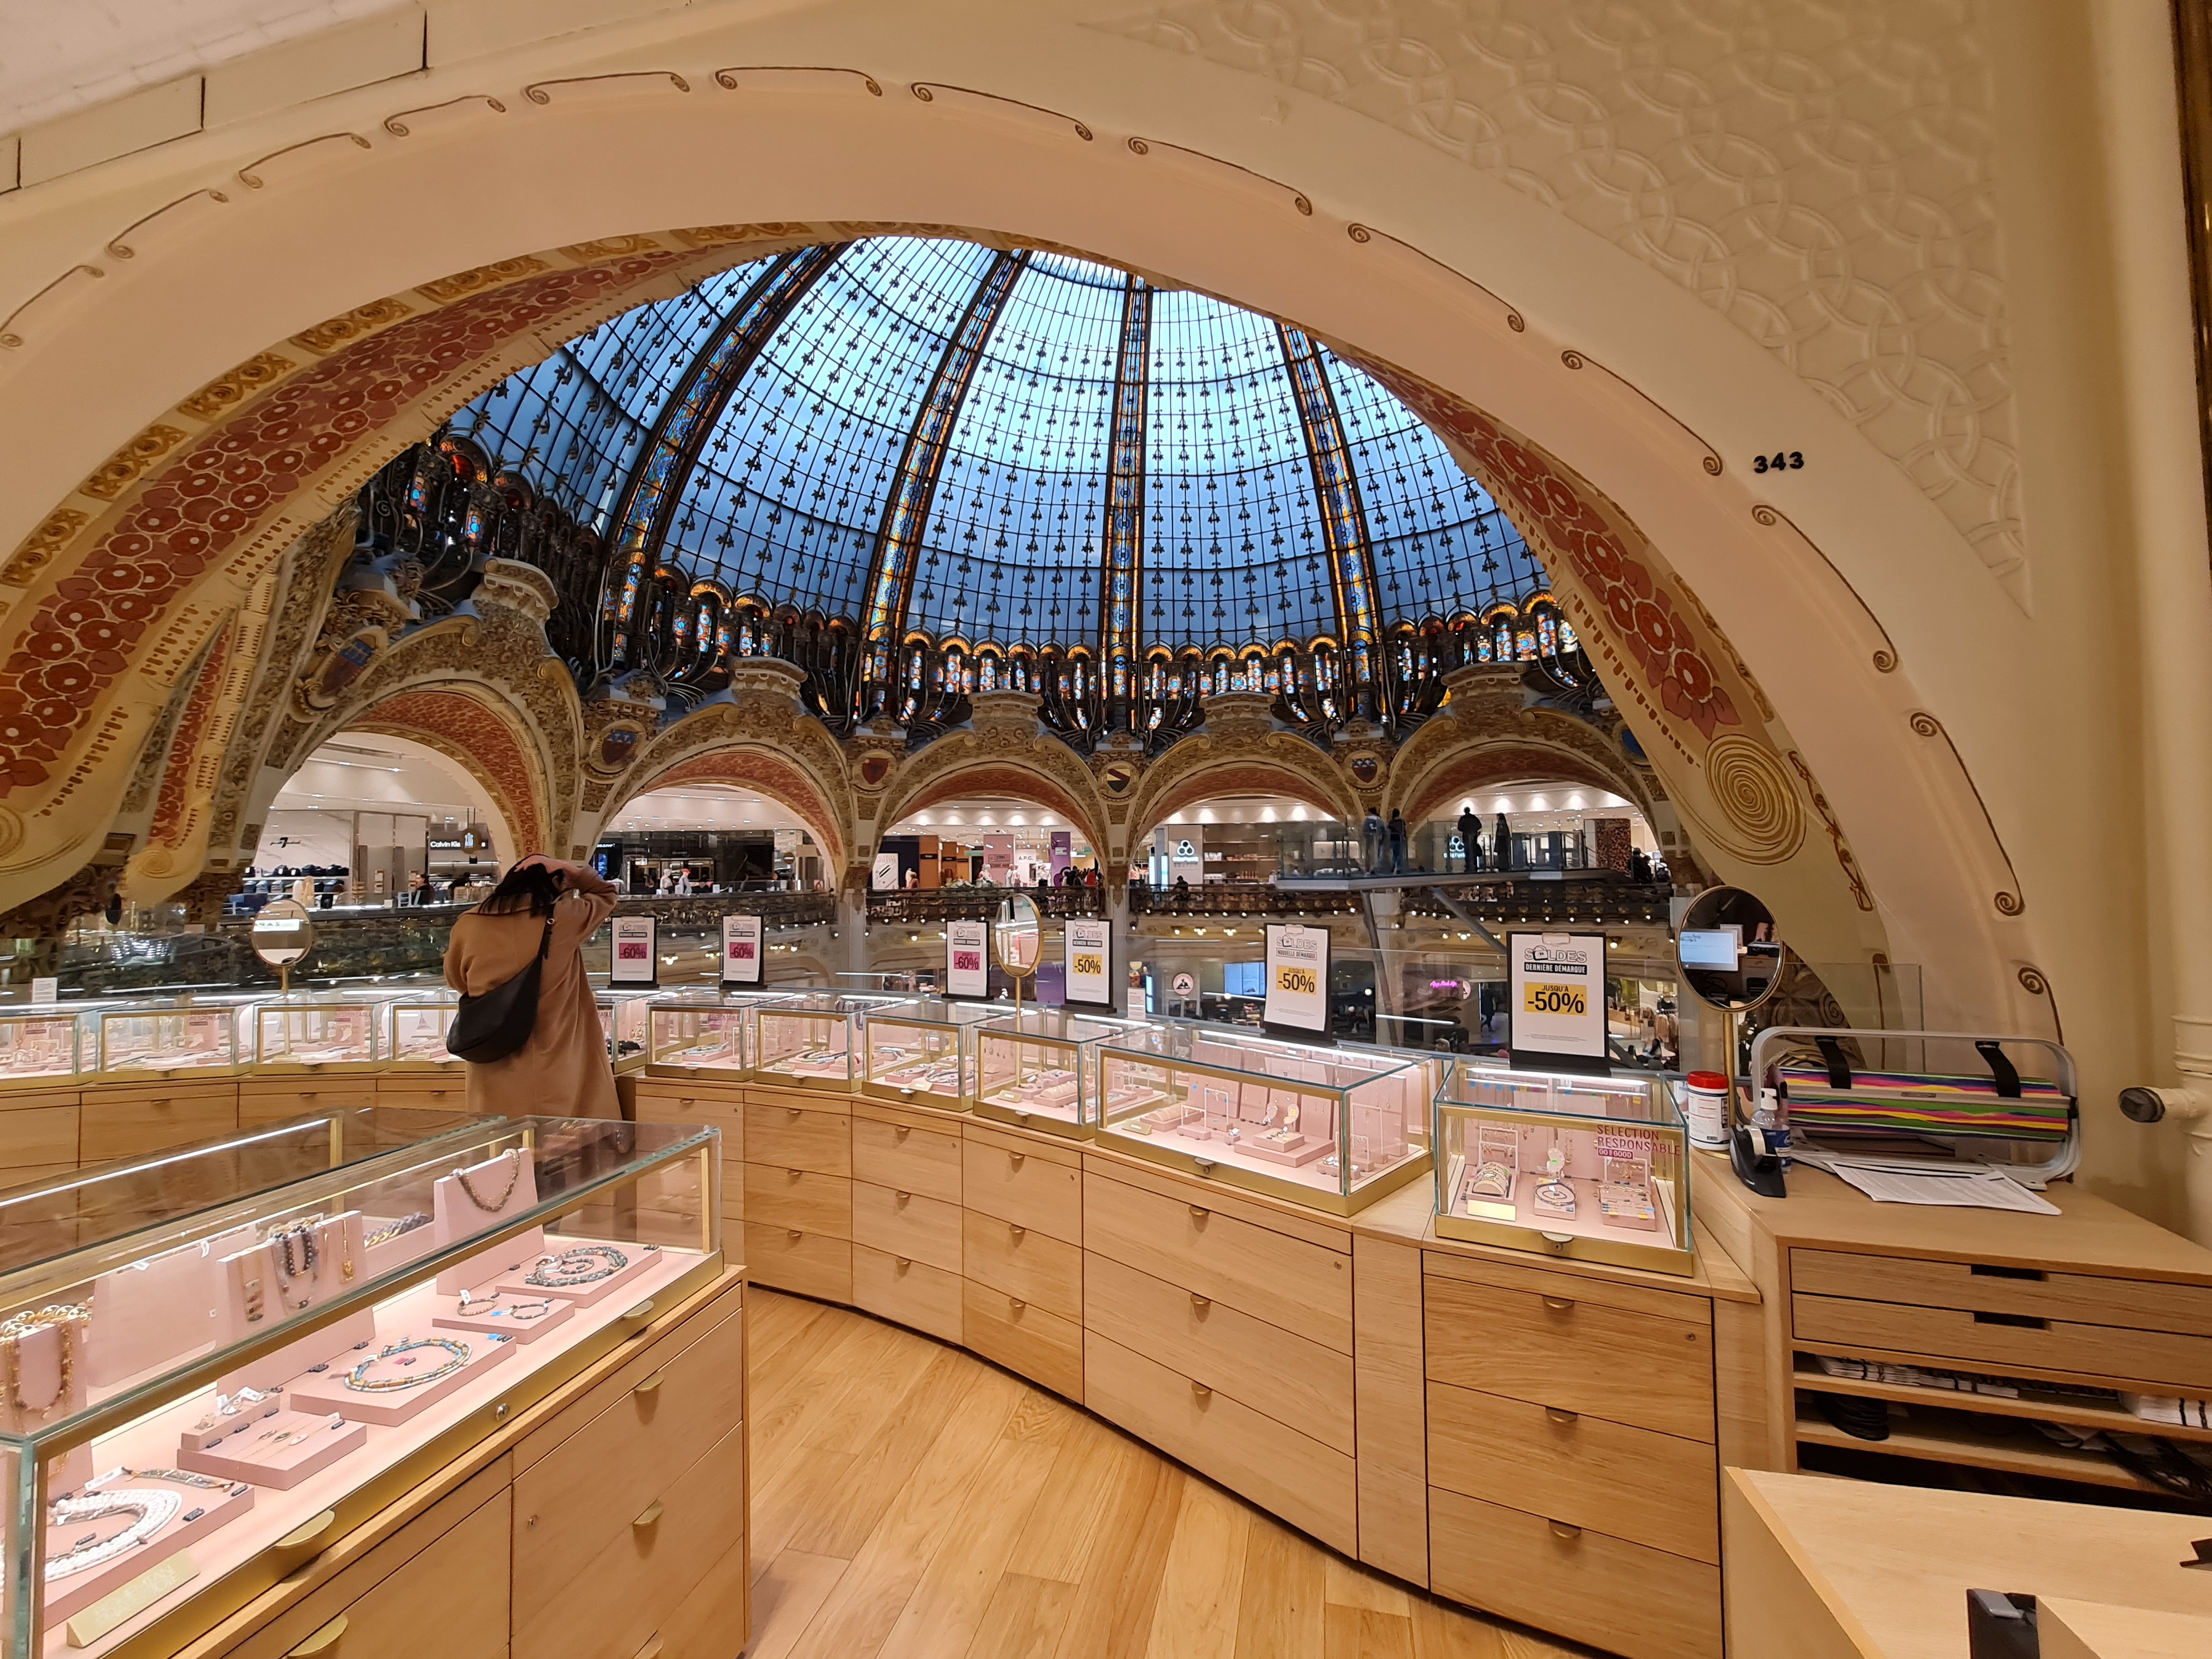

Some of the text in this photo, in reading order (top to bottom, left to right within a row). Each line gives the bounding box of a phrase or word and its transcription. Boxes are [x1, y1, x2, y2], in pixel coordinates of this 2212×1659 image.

[1754, 451, 1804, 474] 343
[1526, 963, 1585, 974] DERNIÈRE DÉMARQUE
[1597, 1125, 1659, 1140] SELECTION
[1598, 1136, 1681, 1156] RESPONSABLE
